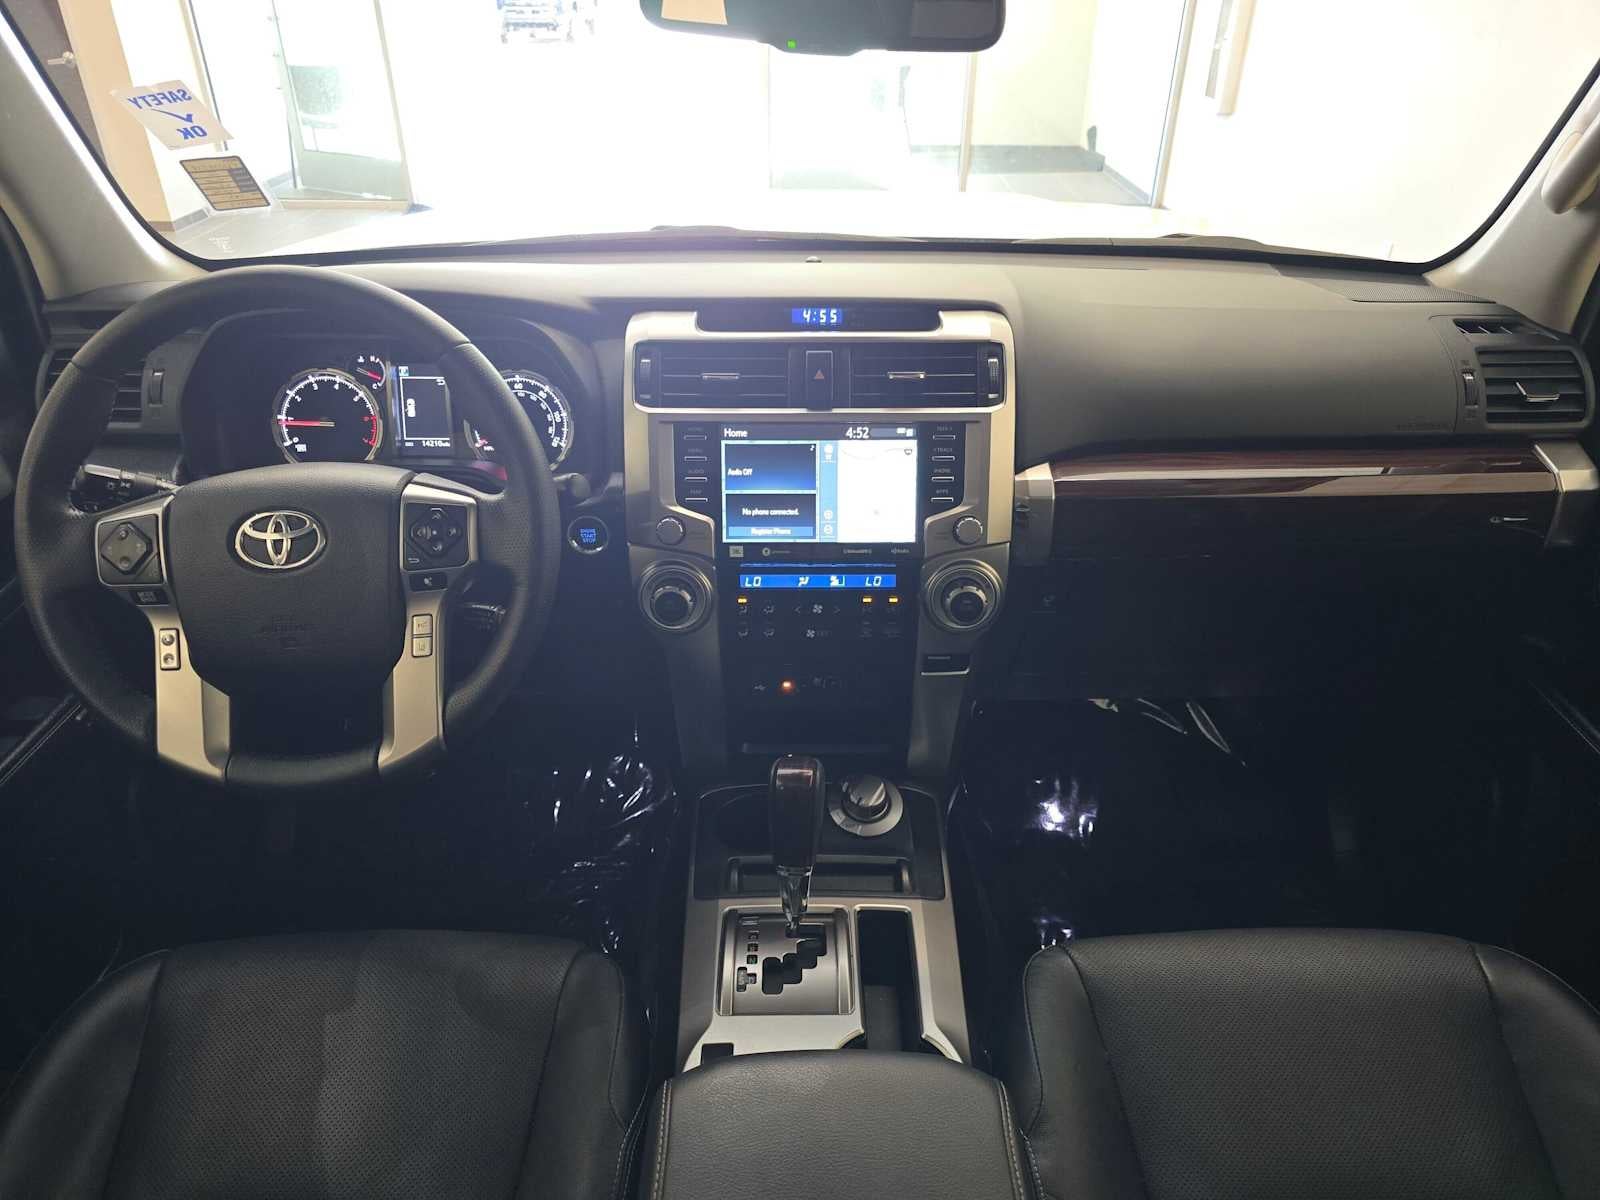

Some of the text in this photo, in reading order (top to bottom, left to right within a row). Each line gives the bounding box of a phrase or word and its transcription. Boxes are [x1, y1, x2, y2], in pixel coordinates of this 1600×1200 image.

[802, 308, 838, 323] 4:55
[723, 428, 748, 438] Home
[845, 427, 870, 439] 4:52
[727, 467, 753, 476] Audio Off
[742, 507, 752, 516] No
[752, 507, 770, 517] phone
[744, 576, 762, 588] LO
[864, 576, 882, 588] LO
